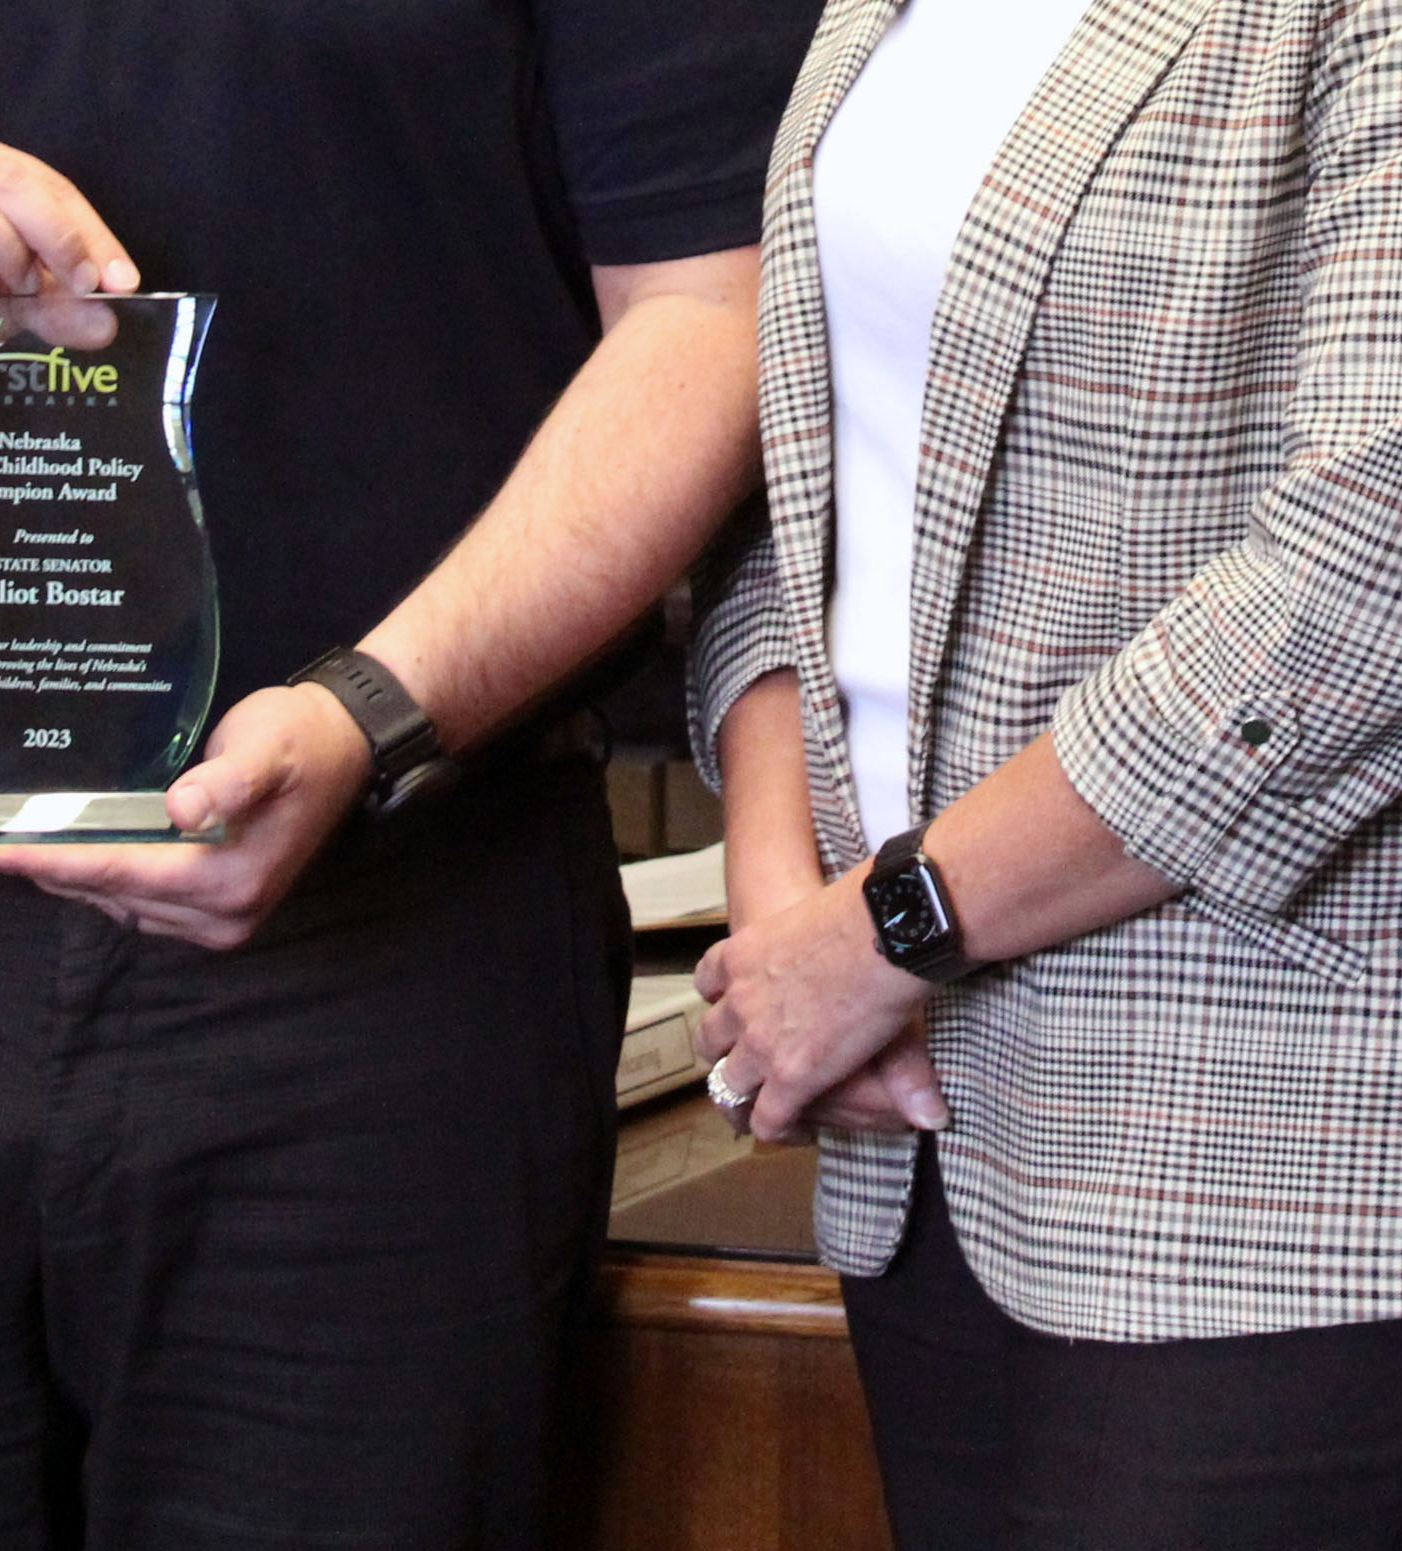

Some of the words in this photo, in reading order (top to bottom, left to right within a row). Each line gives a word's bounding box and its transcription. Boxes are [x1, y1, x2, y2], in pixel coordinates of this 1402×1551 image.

[87, 457, 144, 482] Policy
[57, 482, 118, 502] Award
[12, 528, 79, 544] Presented
[79, 531, 95, 544] to
[42, 558, 113, 573] SENATOR
[45, 580, 126, 607] Bostar
[10, 637, 63, 656] leadership
[63, 639, 86, 653] and
[86, 641, 153, 654] commitment
[35, 658, 54, 671] the
[54, 658, 78, 672] lives
[78, 659, 94, 675] of
[91, 658, 147, 673] Nebraska's
[35, 677, 82, 693] families,
[83, 677, 107, 692] and
[106, 679, 173, 693] communities
[22, 728, 73, 749] 2023
